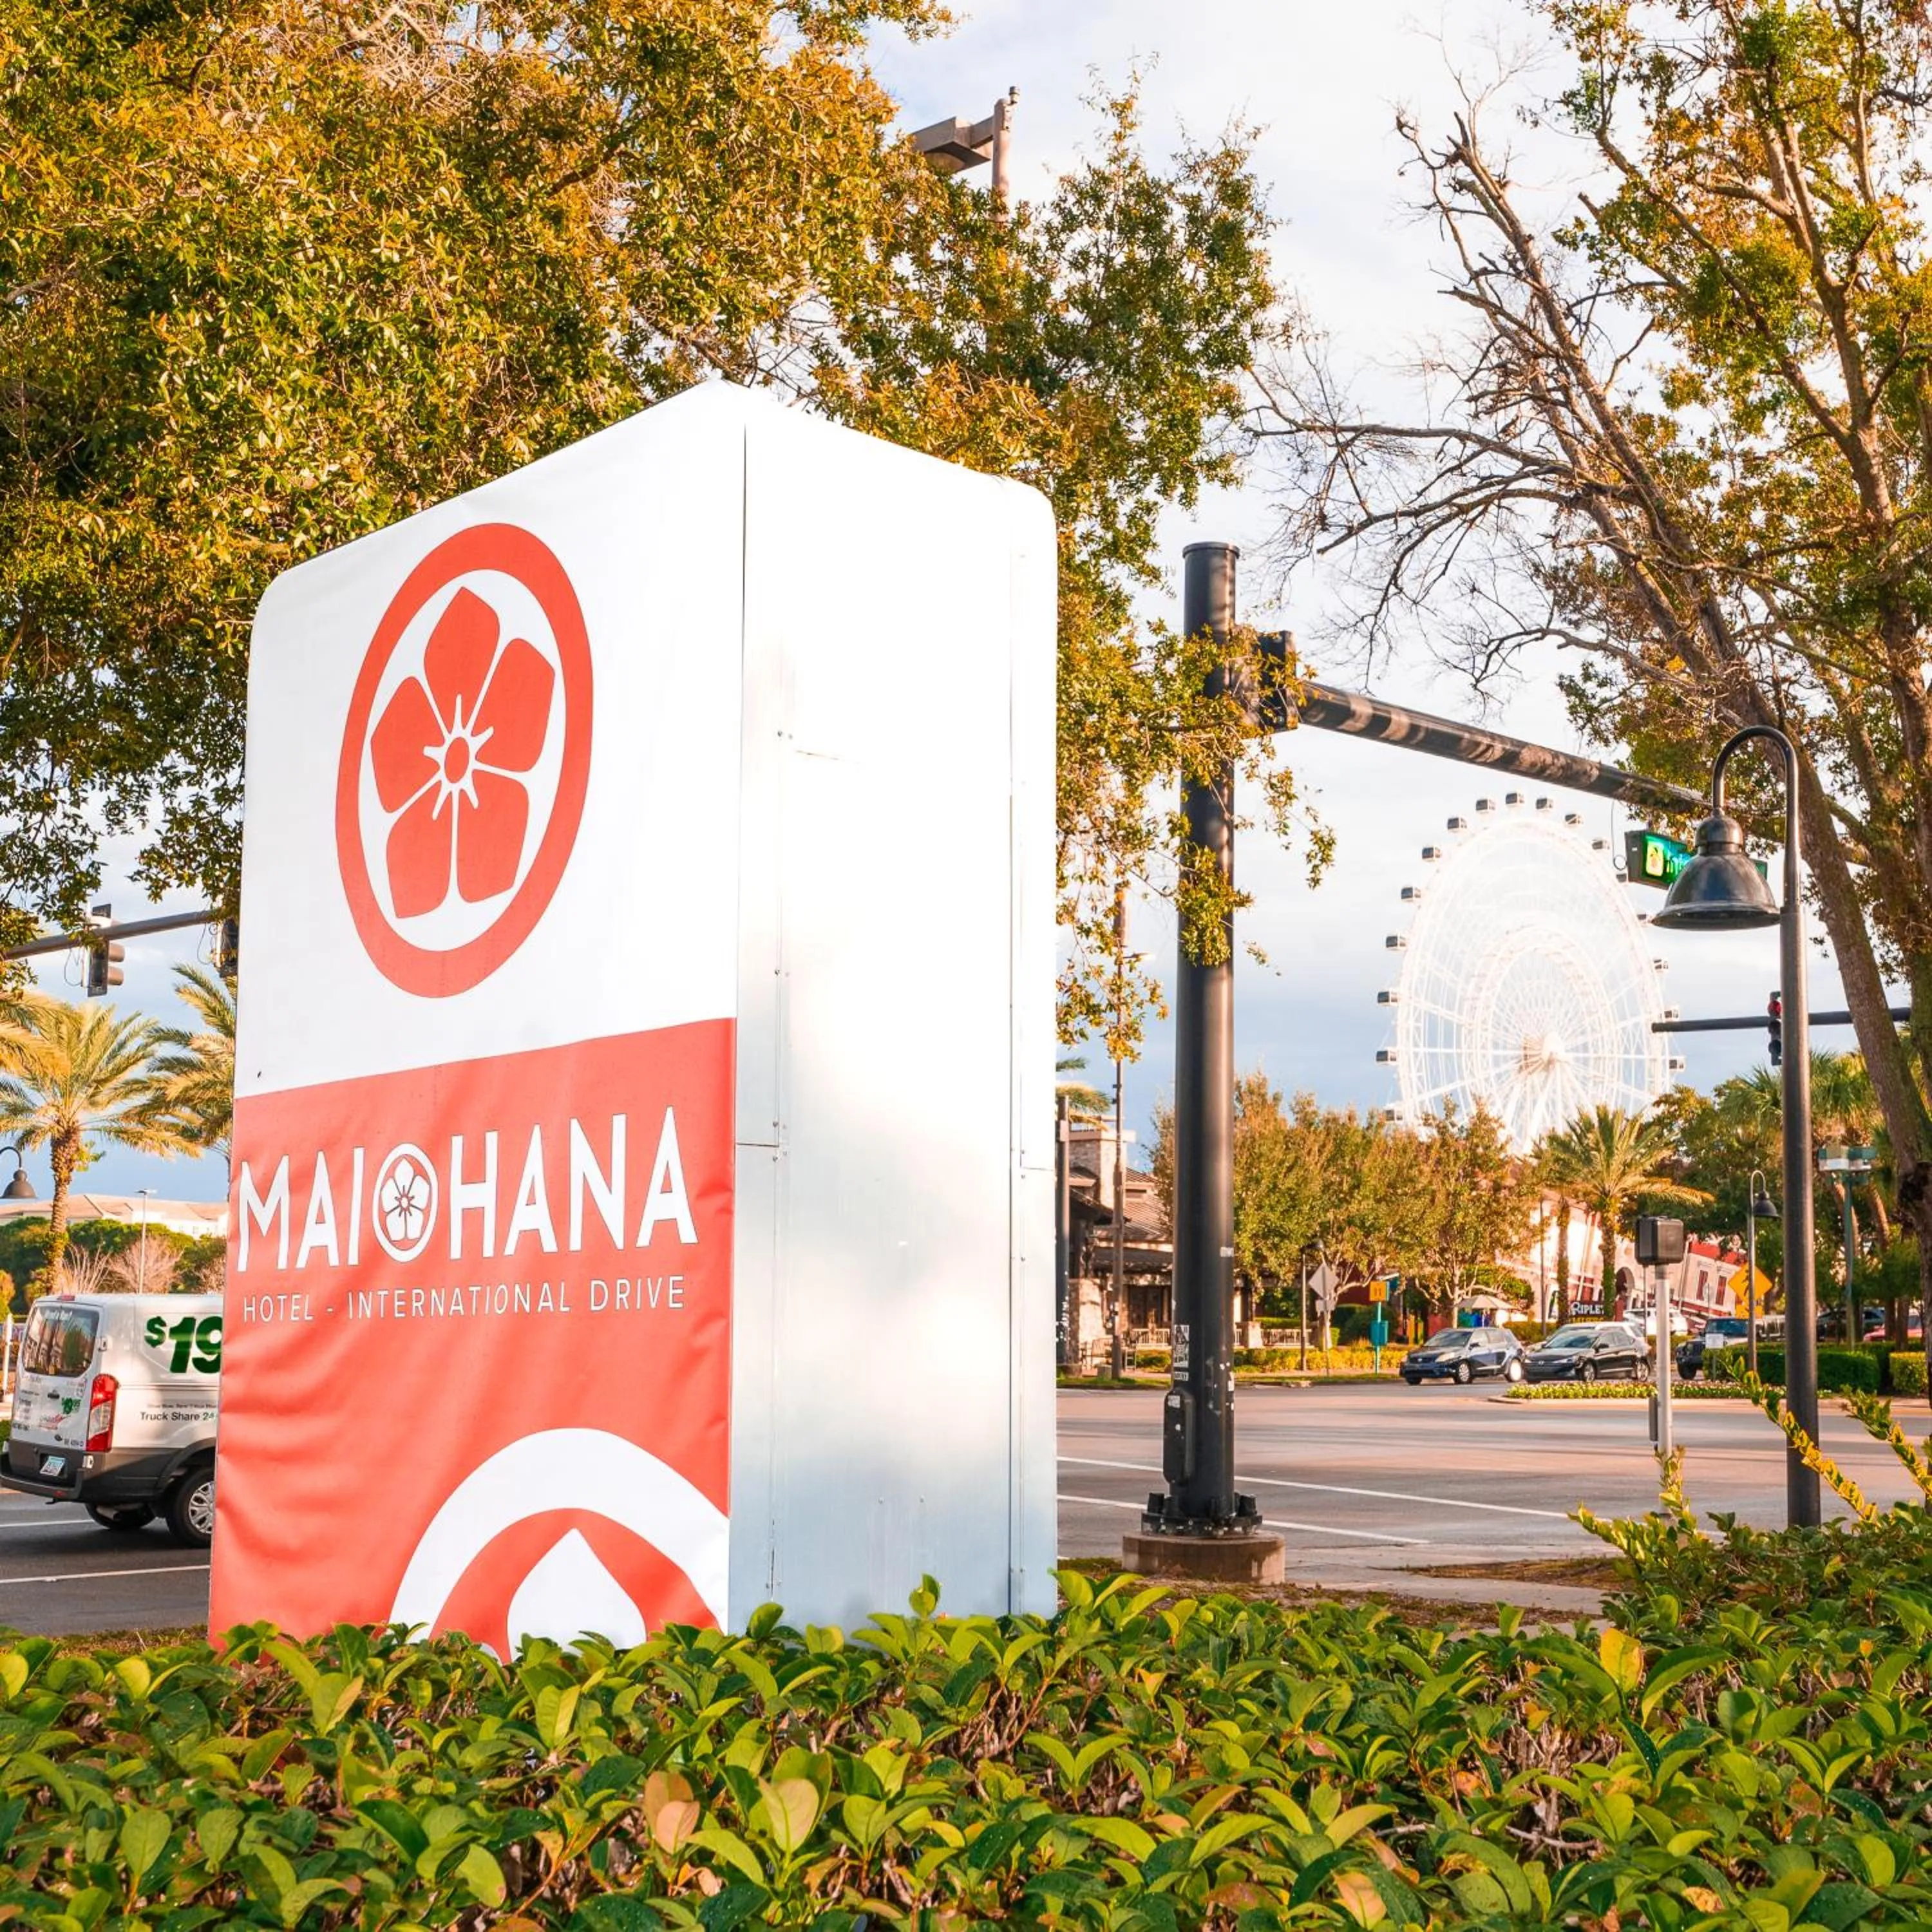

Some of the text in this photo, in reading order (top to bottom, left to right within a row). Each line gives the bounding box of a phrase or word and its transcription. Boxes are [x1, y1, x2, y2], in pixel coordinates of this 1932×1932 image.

[243, 1293, 314, 1323] HOTEL
[347, 1283, 571, 1320] INTERNATIONAL
[590, 1275, 685, 1312] DRIVE
[144, 1316, 223, 1374] $19
[140, 1411, 169, 1421] Truck
[171, 1411, 200, 1421] Share
